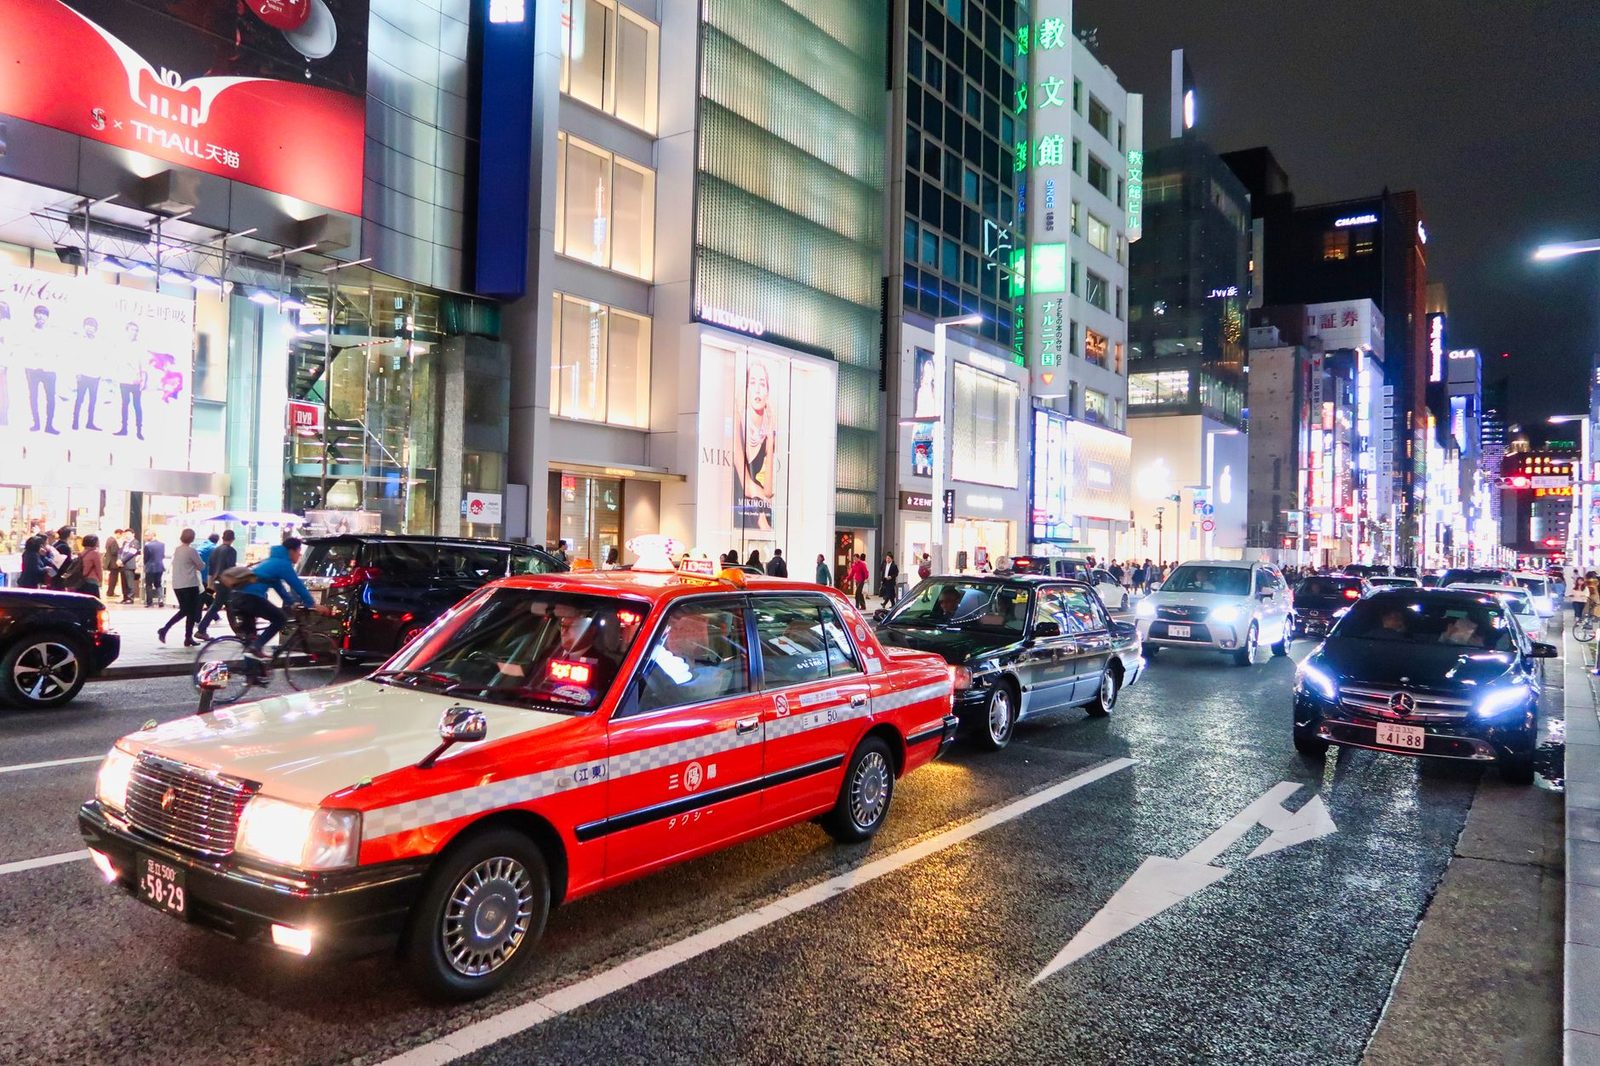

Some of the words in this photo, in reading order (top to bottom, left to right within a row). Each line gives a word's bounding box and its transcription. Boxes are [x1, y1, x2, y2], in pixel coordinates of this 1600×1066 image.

[130, 119, 204, 158] TMALL
[1045, 178, 1055, 209] SINCE
[1042, 301, 1055, 367] ナルニア国
[827, 710, 838, 722] 50
[1386, 732, 1421, 747] 41-88
[669, 810, 713, 830] タクシー
[146, 873, 184, 912] 58-29
